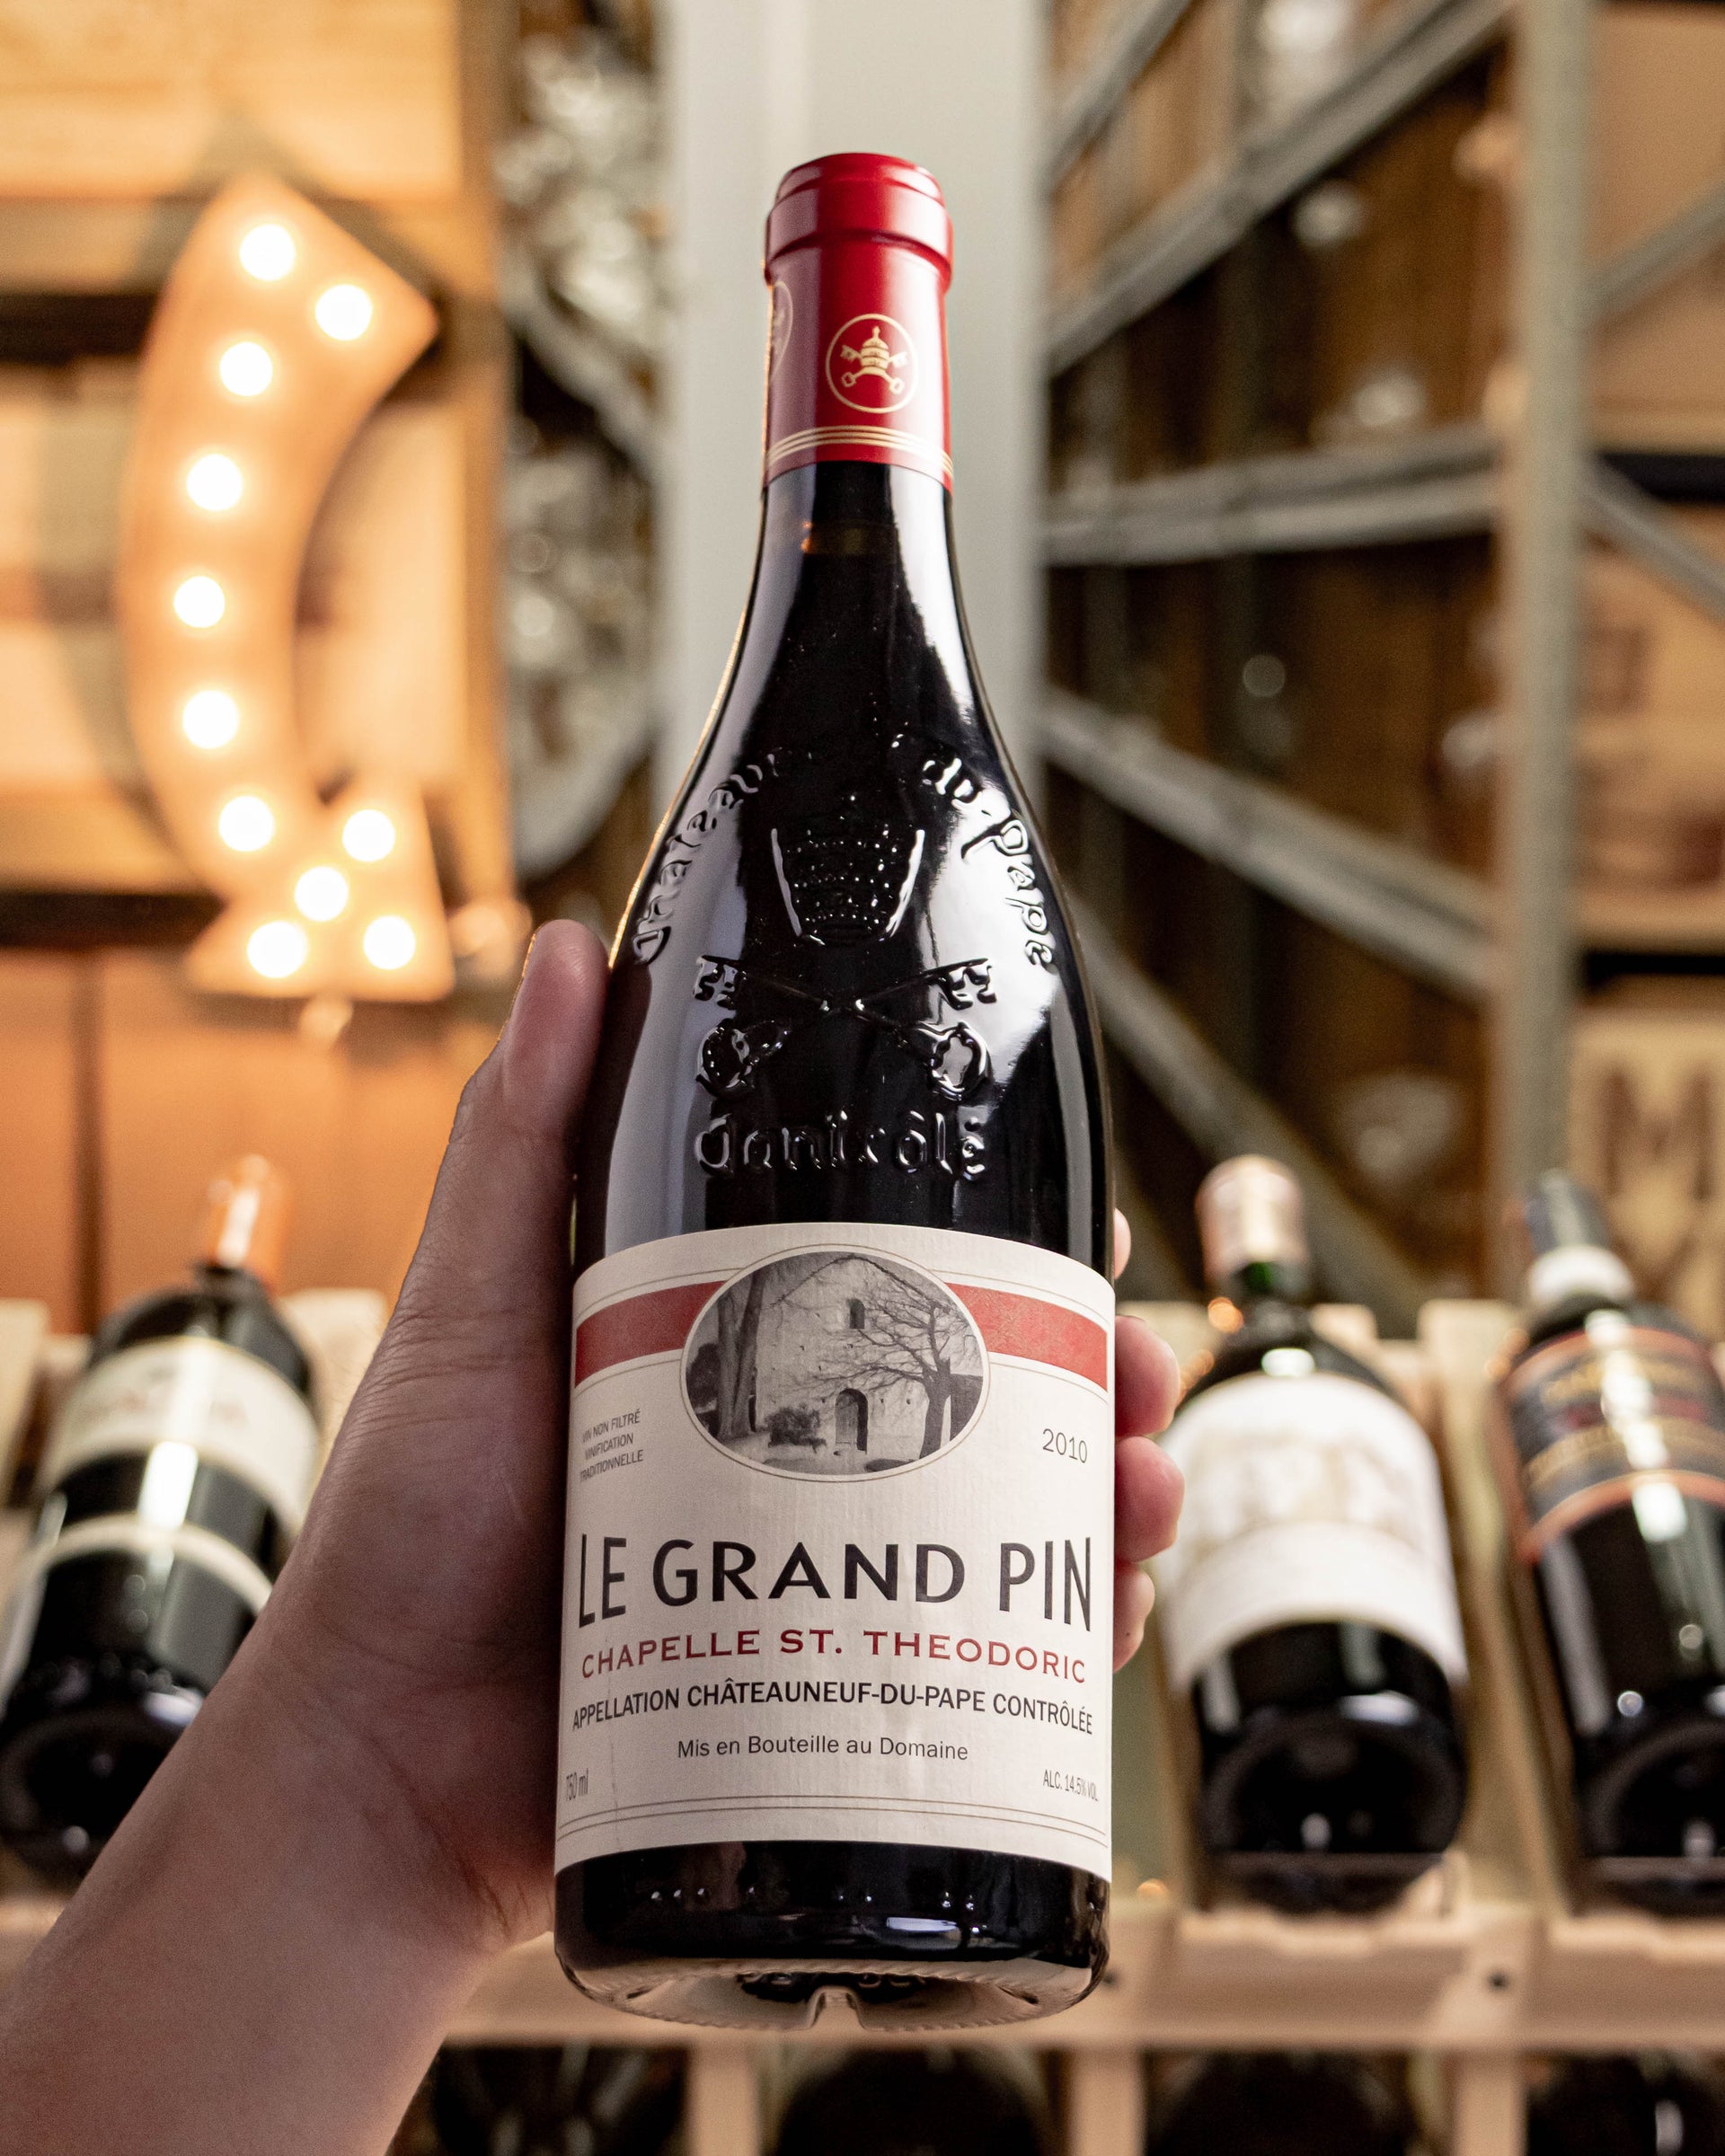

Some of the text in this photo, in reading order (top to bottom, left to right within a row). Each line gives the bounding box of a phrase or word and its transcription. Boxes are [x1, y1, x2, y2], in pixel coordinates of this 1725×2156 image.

[593, 1421, 609, 1437] NON
[612, 1409, 641, 1430] FILTRÉ
[585, 1432, 634, 1461] VINIFICATION
[1042, 1427, 1089, 1464] 2010
[579, 1449, 644, 1482] TRADITIONNELLE
[578, 1533, 1092, 1632] LE GRAND PIN
[581, 1629, 1086, 1684] CHAPELLE ST. THEODORIC
[572, 1677, 1094, 1736] APPELLATION CHÂTEAUNEUF-DU-PAPE CONTRÔLÉE
[677, 1735, 969, 1762] Mis en Bouteille au Domaine
[579, 1767, 589, 1797] ml
[1042, 1768, 1063, 1790] ALC.
